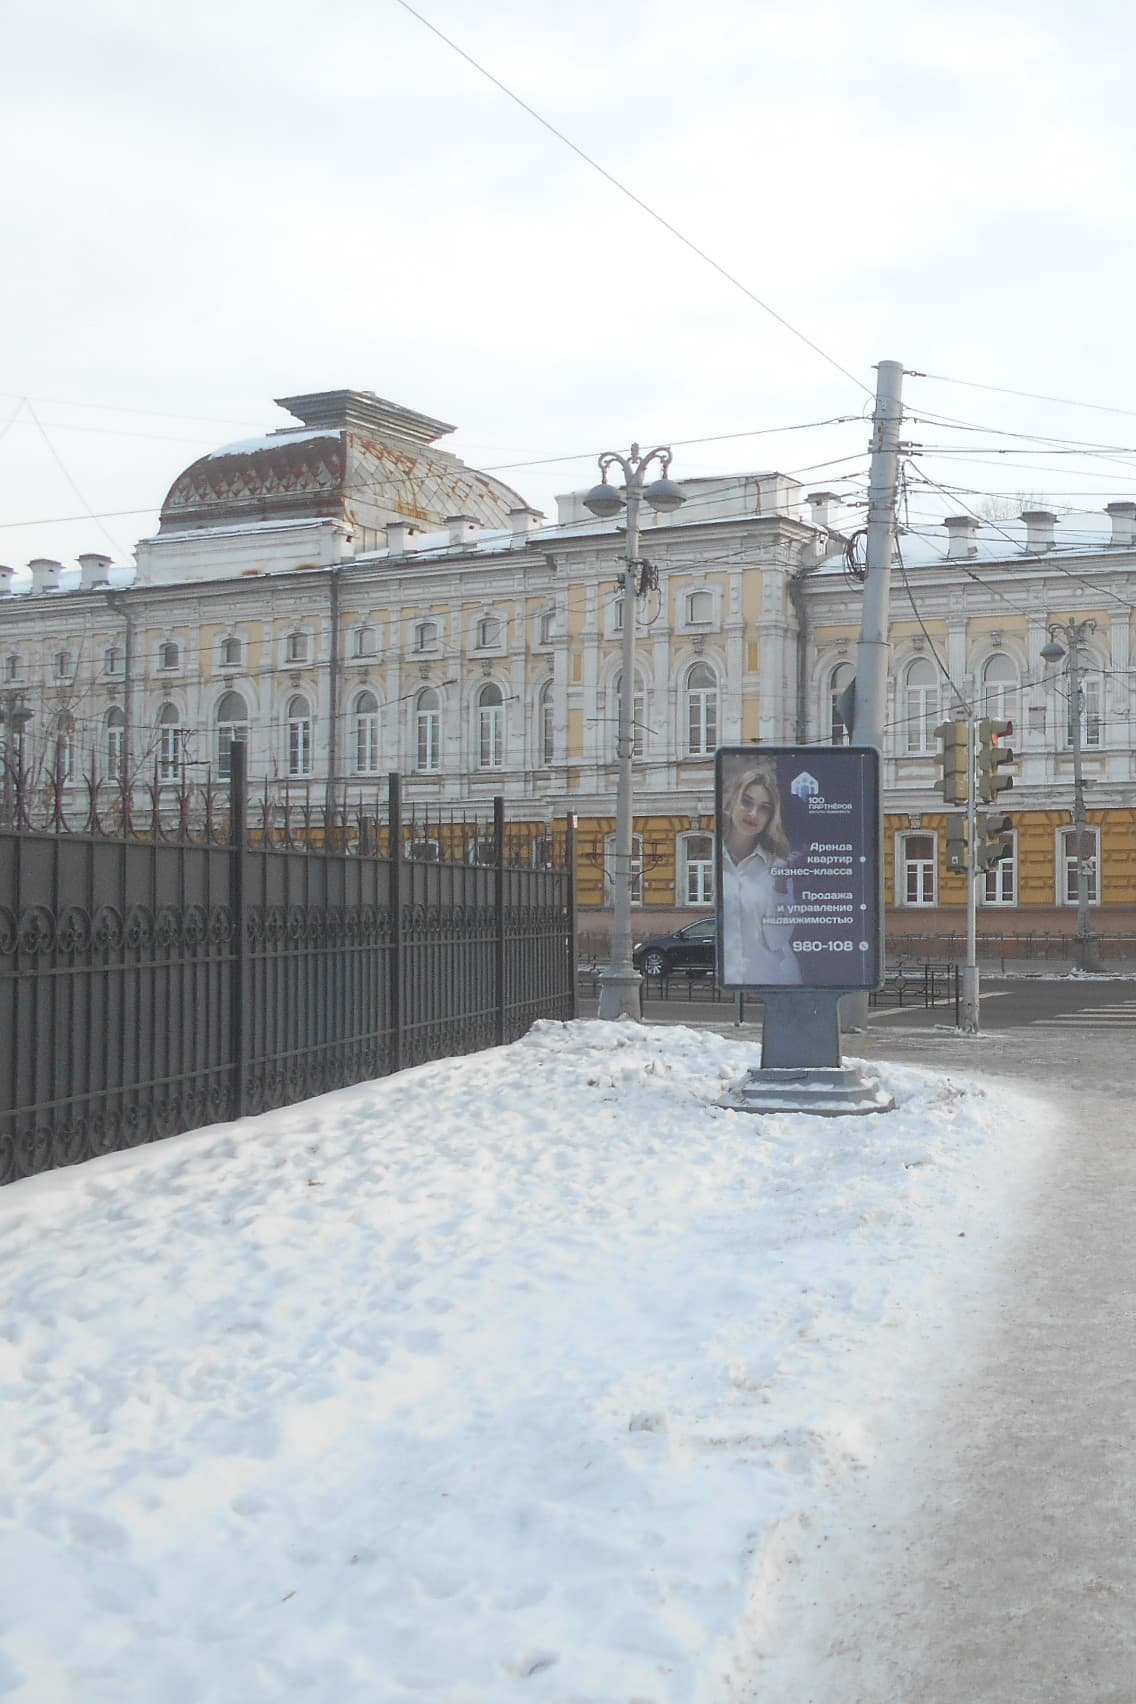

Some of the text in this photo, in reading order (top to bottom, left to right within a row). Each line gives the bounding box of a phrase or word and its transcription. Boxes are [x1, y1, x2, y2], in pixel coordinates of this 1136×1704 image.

[810, 842, 853, 852] Аренда
[807, 856, 853, 864] квартир
[770, 867, 853, 876] бизнес-класса
[802, 891, 853, 901] Продажа
[777, 904, 853, 913] и управление
[763, 916, 853, 924] недвижимостью
[792, 941, 854, 952] 980-108
